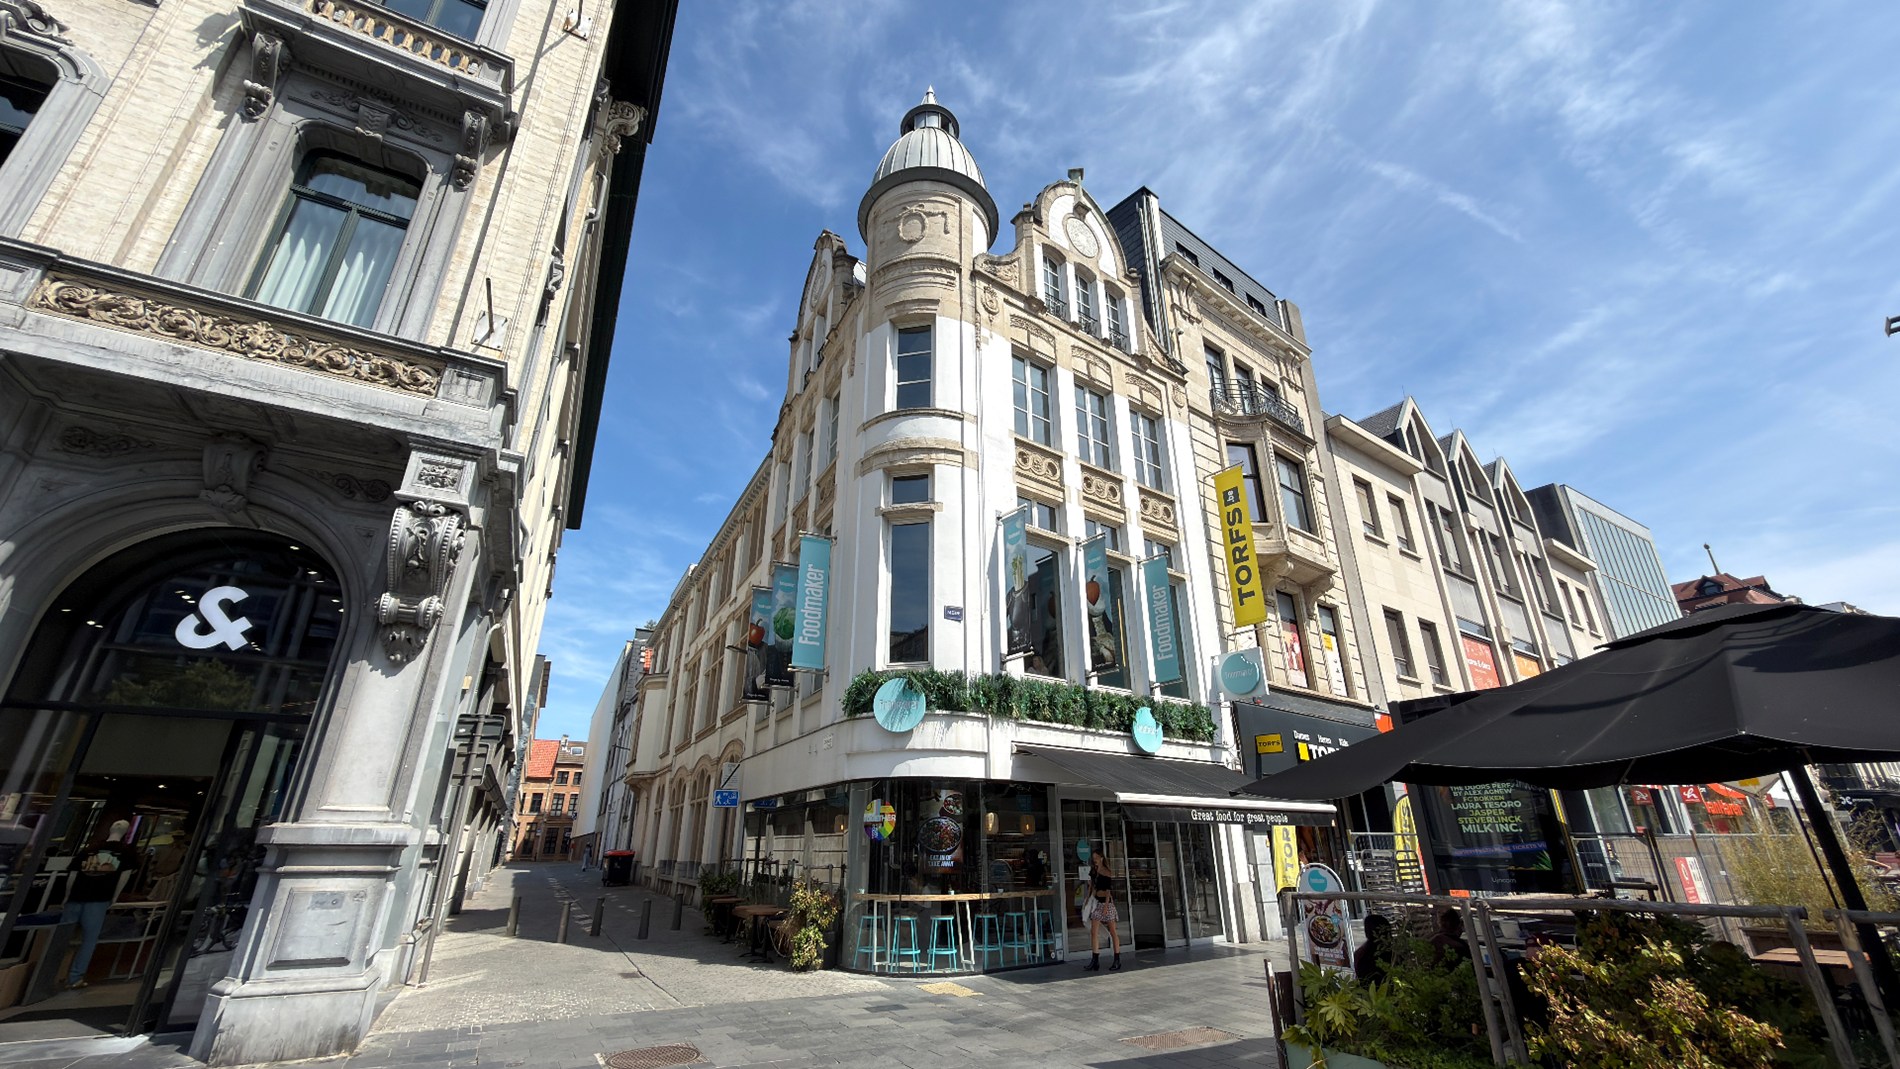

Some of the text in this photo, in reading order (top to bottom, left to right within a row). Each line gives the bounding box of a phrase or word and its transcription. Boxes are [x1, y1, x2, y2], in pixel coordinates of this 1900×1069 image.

[1226, 507, 1256, 606] TORFS
[798, 563, 825, 646] Foodmaker
[175, 585, 253, 651] &
[1152, 584, 1175, 661] Foodmaker
[1451, 800, 1522, 810] LAURA TESORO
[1469, 808, 1506, 817] JASPER
[1191, 809, 1288, 825] Great food for great people
[1457, 815, 1523, 824] STEVERLINCK
[1461, 823, 1523, 833] MILK INC.
